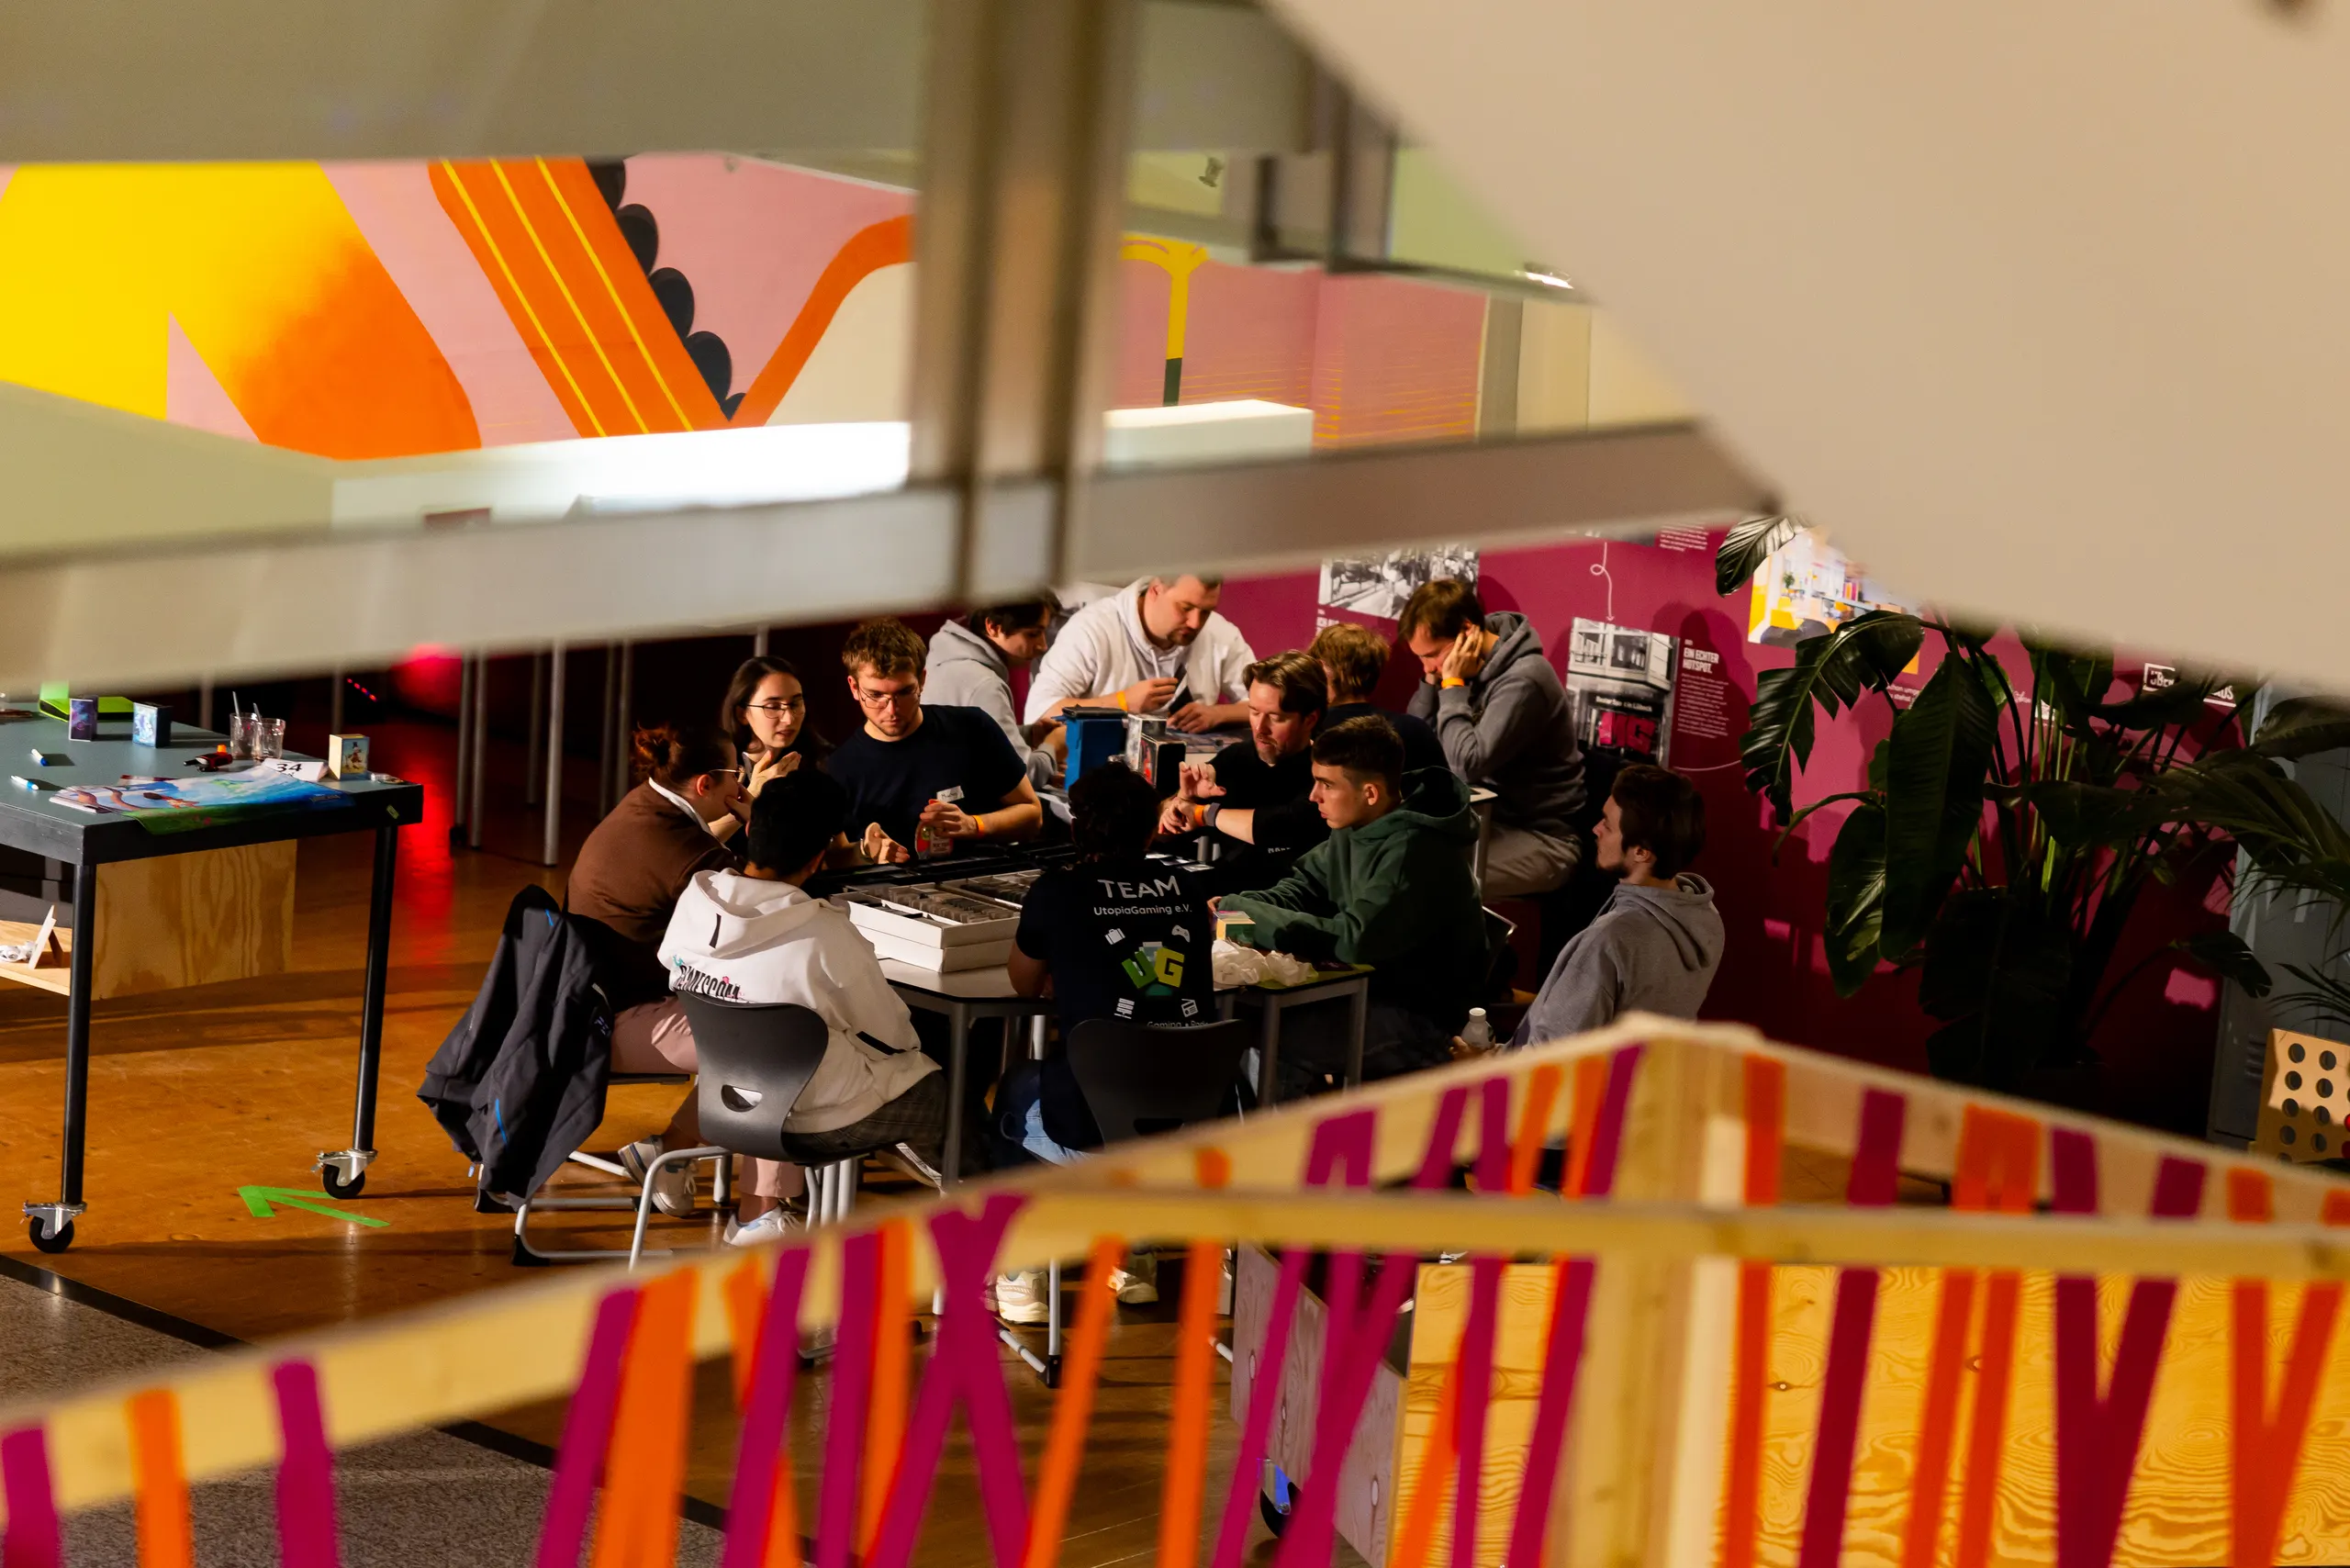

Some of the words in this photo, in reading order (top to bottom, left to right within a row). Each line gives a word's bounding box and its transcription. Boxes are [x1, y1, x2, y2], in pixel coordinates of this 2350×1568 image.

[276, 763, 302, 772] 34
[1097, 875, 1181, 899] TEAM
[1093, 905, 1172, 916] UtopiaGaming
[1174, 903, 1192, 913] e.V.
